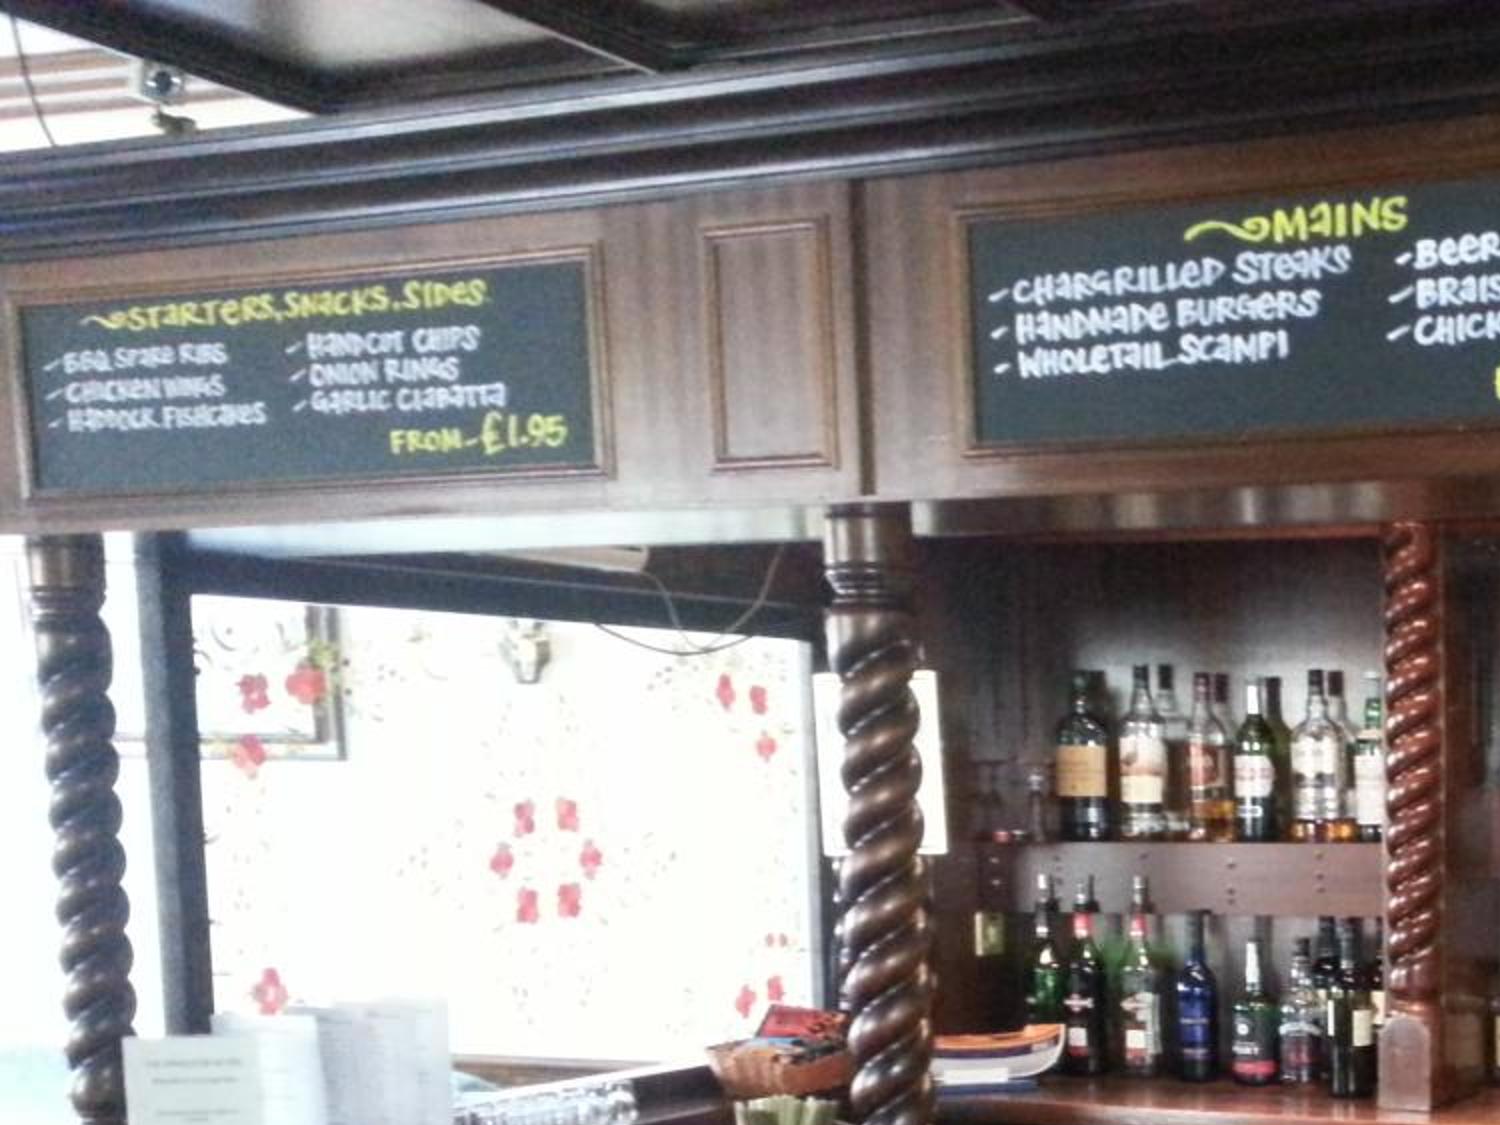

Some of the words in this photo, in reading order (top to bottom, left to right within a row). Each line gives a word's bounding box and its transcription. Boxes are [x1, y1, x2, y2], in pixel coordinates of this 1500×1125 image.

[1272, 196, 1408, 243] MAINS
[402, 278, 487, 310] SIDES
[1012, 256, 1227, 306] CHARGRILLED
[1231, 244, 1352, 285] STEAKS
[1014, 300, 1169, 345] HANDMADE
[1176, 289, 1322, 330] BURGERS
[308, 360, 380, 387] ONION
[383, 356, 460, 384] RINGS
[1018, 340, 1172, 379] WHOLETAIL
[1178, 329, 1290, 366] SCAMPI
[310, 389, 393, 416] GARLIC
